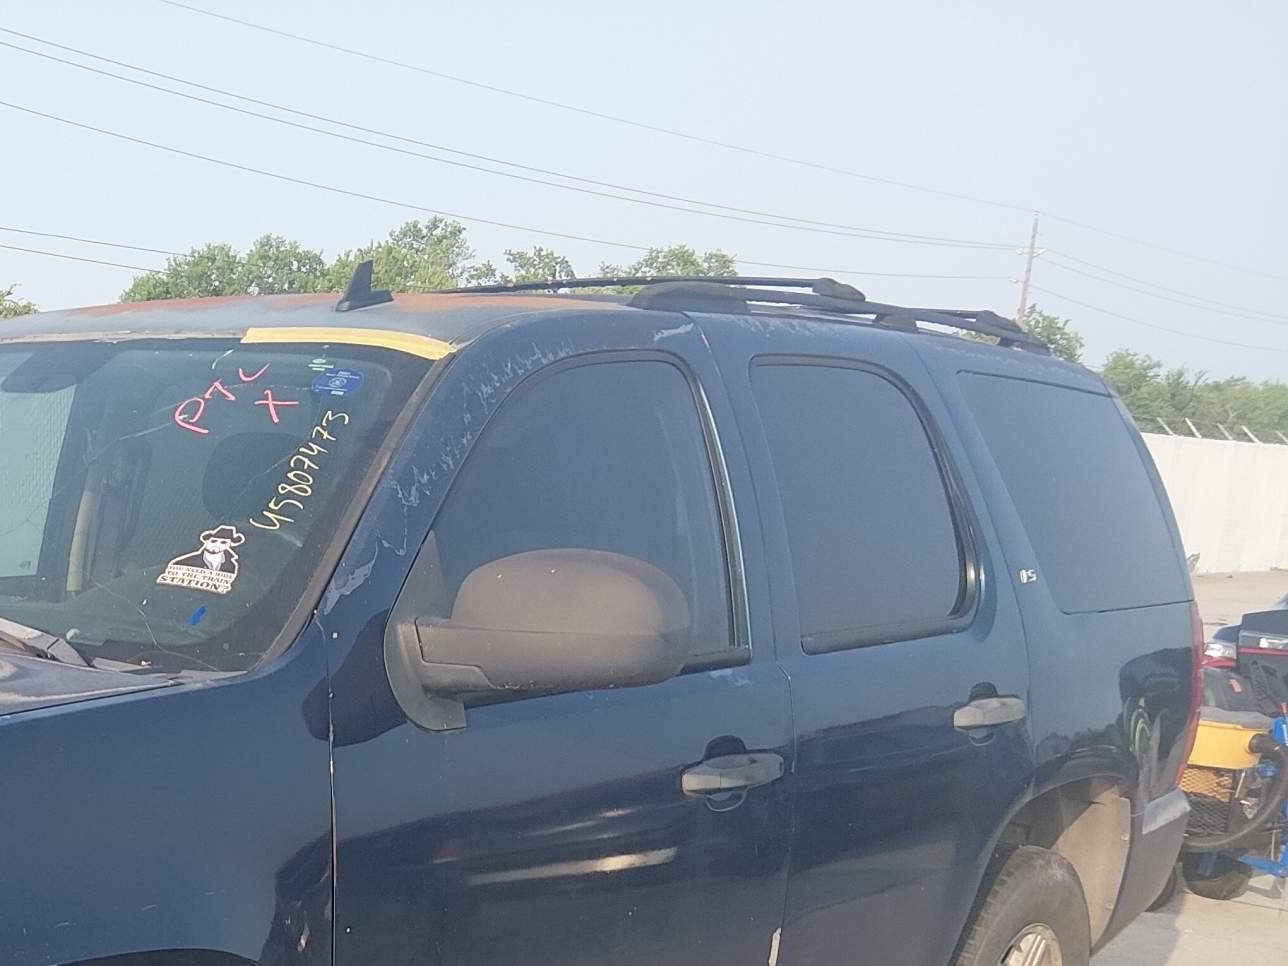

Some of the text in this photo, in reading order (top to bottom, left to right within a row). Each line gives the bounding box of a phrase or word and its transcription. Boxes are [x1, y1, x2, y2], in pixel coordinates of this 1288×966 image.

[249, 410, 349, 530] 45807473
[159, 575, 230, 593] STATION?
[202, 575, 231, 585] TRAIN
